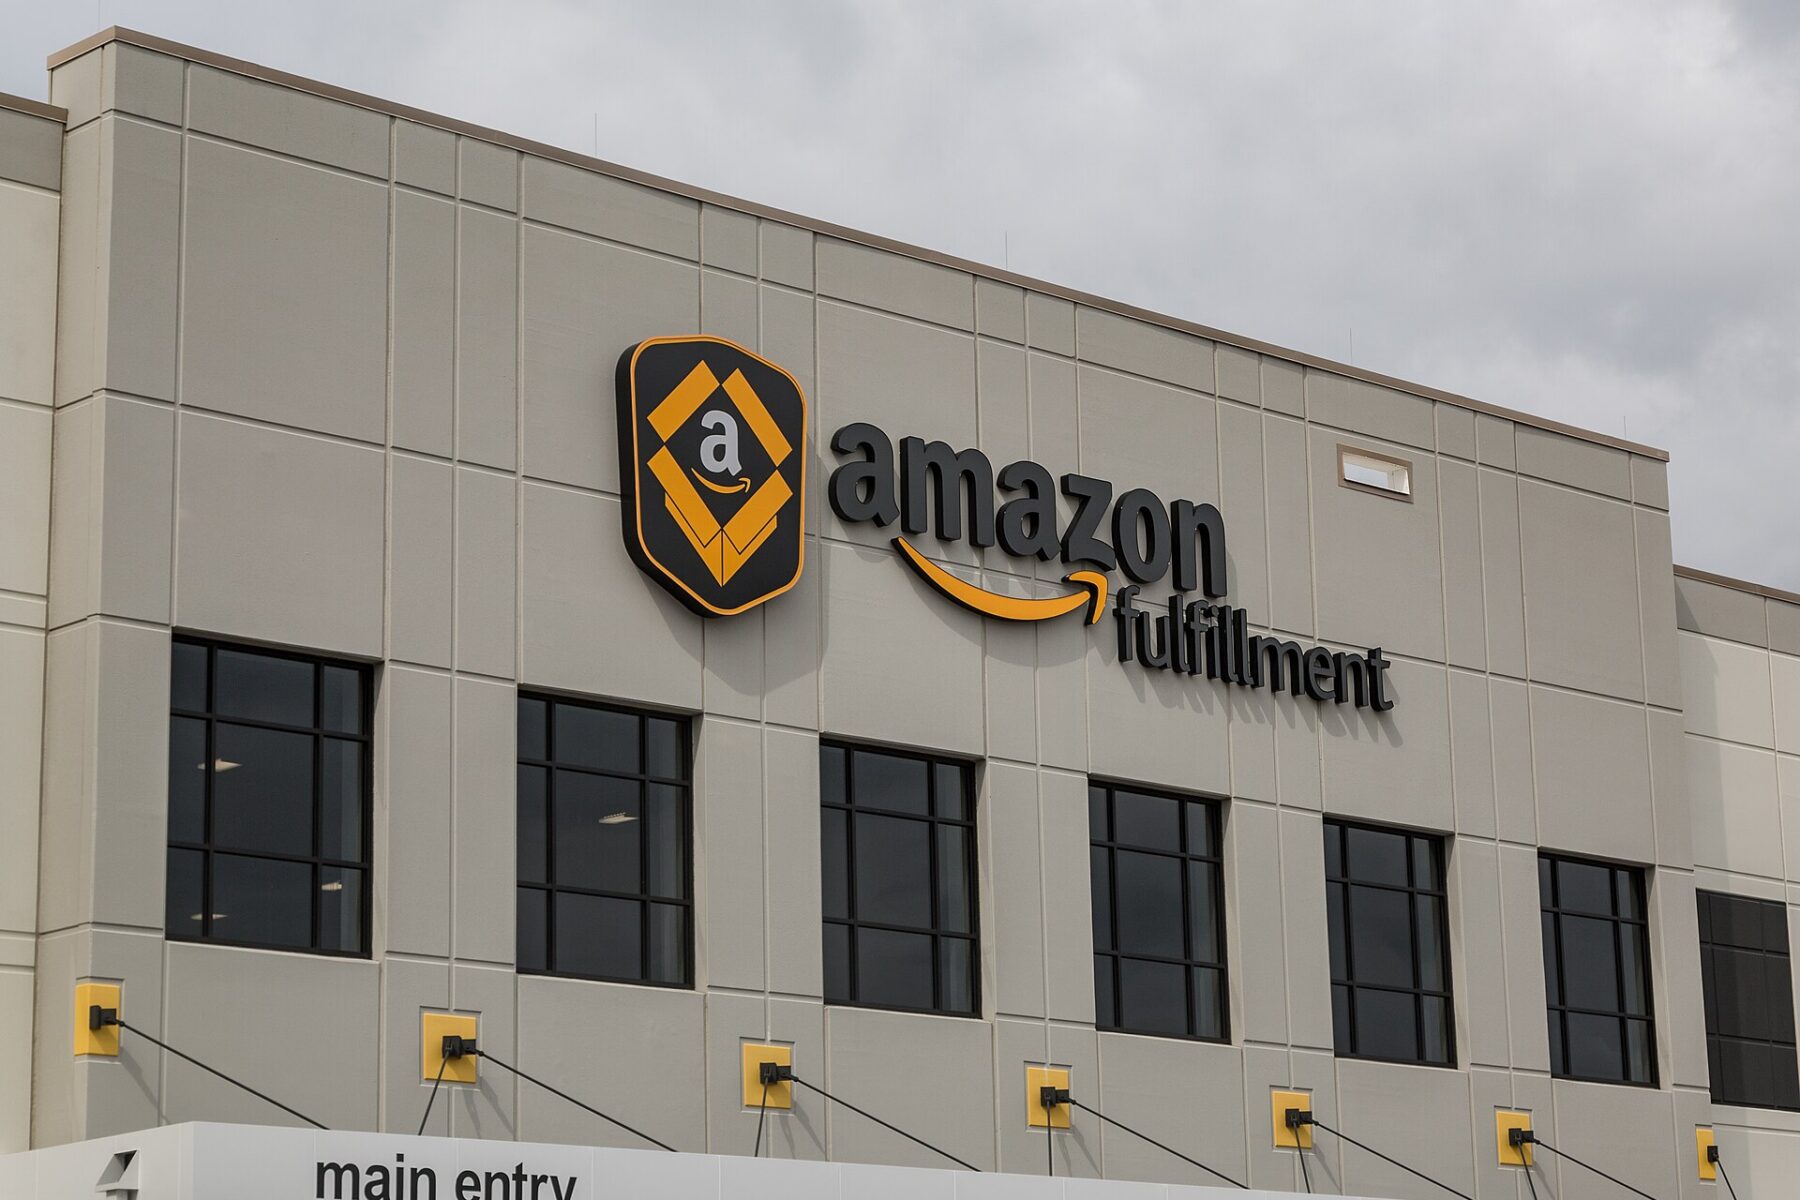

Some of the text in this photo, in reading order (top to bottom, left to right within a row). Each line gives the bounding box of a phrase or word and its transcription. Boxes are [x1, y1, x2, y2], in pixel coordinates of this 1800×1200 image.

[700, 409, 742, 476] a
[828, 422, 1227, 597] amazon
[1113, 585, 1394, 711] fulfillment
[316, 1153, 437, 1200] main
